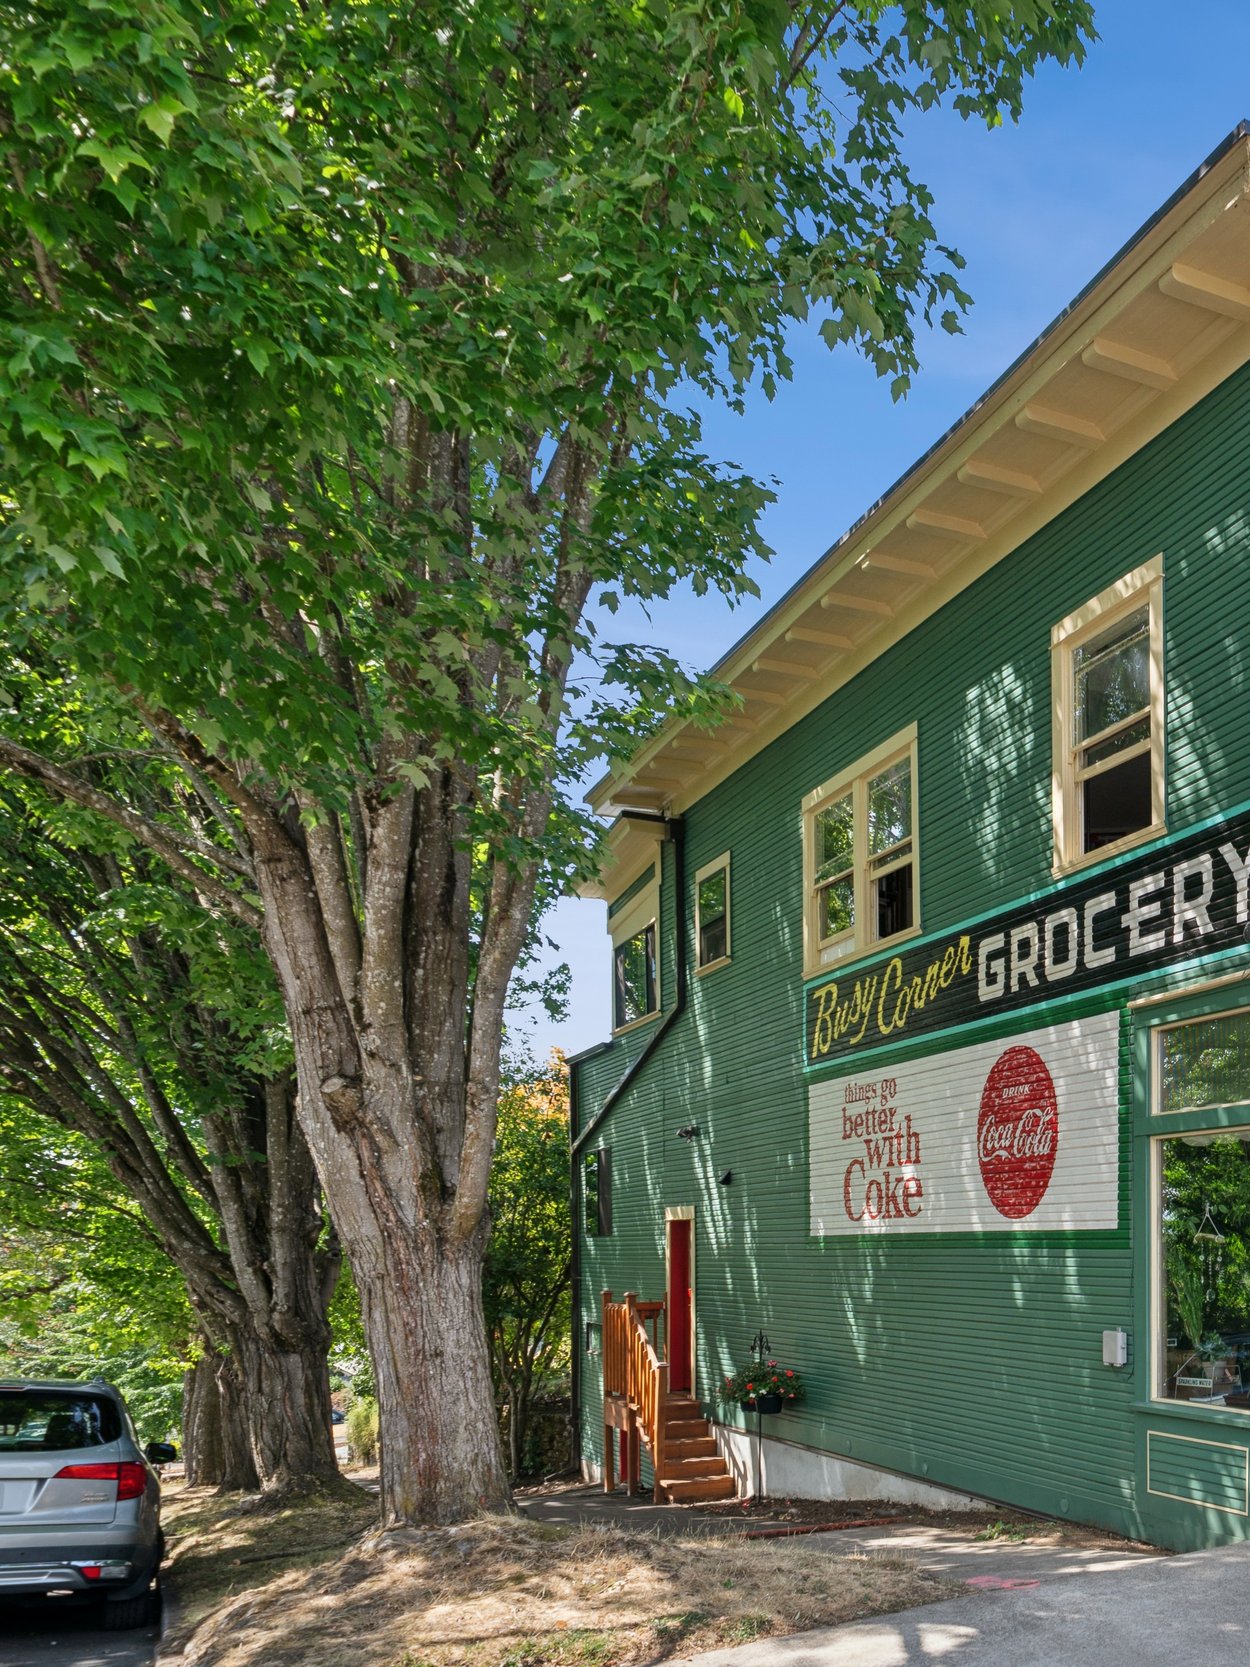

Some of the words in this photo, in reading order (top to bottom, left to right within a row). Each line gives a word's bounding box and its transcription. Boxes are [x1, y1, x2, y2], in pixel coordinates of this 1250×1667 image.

[812, 976, 878, 1058] Busy
[878, 936, 972, 1034] Corner
[845, 1083, 877, 1104] things
[880, 1078, 897, 1106] go
[1002, 1085, 1030, 1098] DRINK
[842, 1106, 896, 1140] better
[864, 1114, 921, 1169] with
[843, 1159, 923, 1221] Coke
